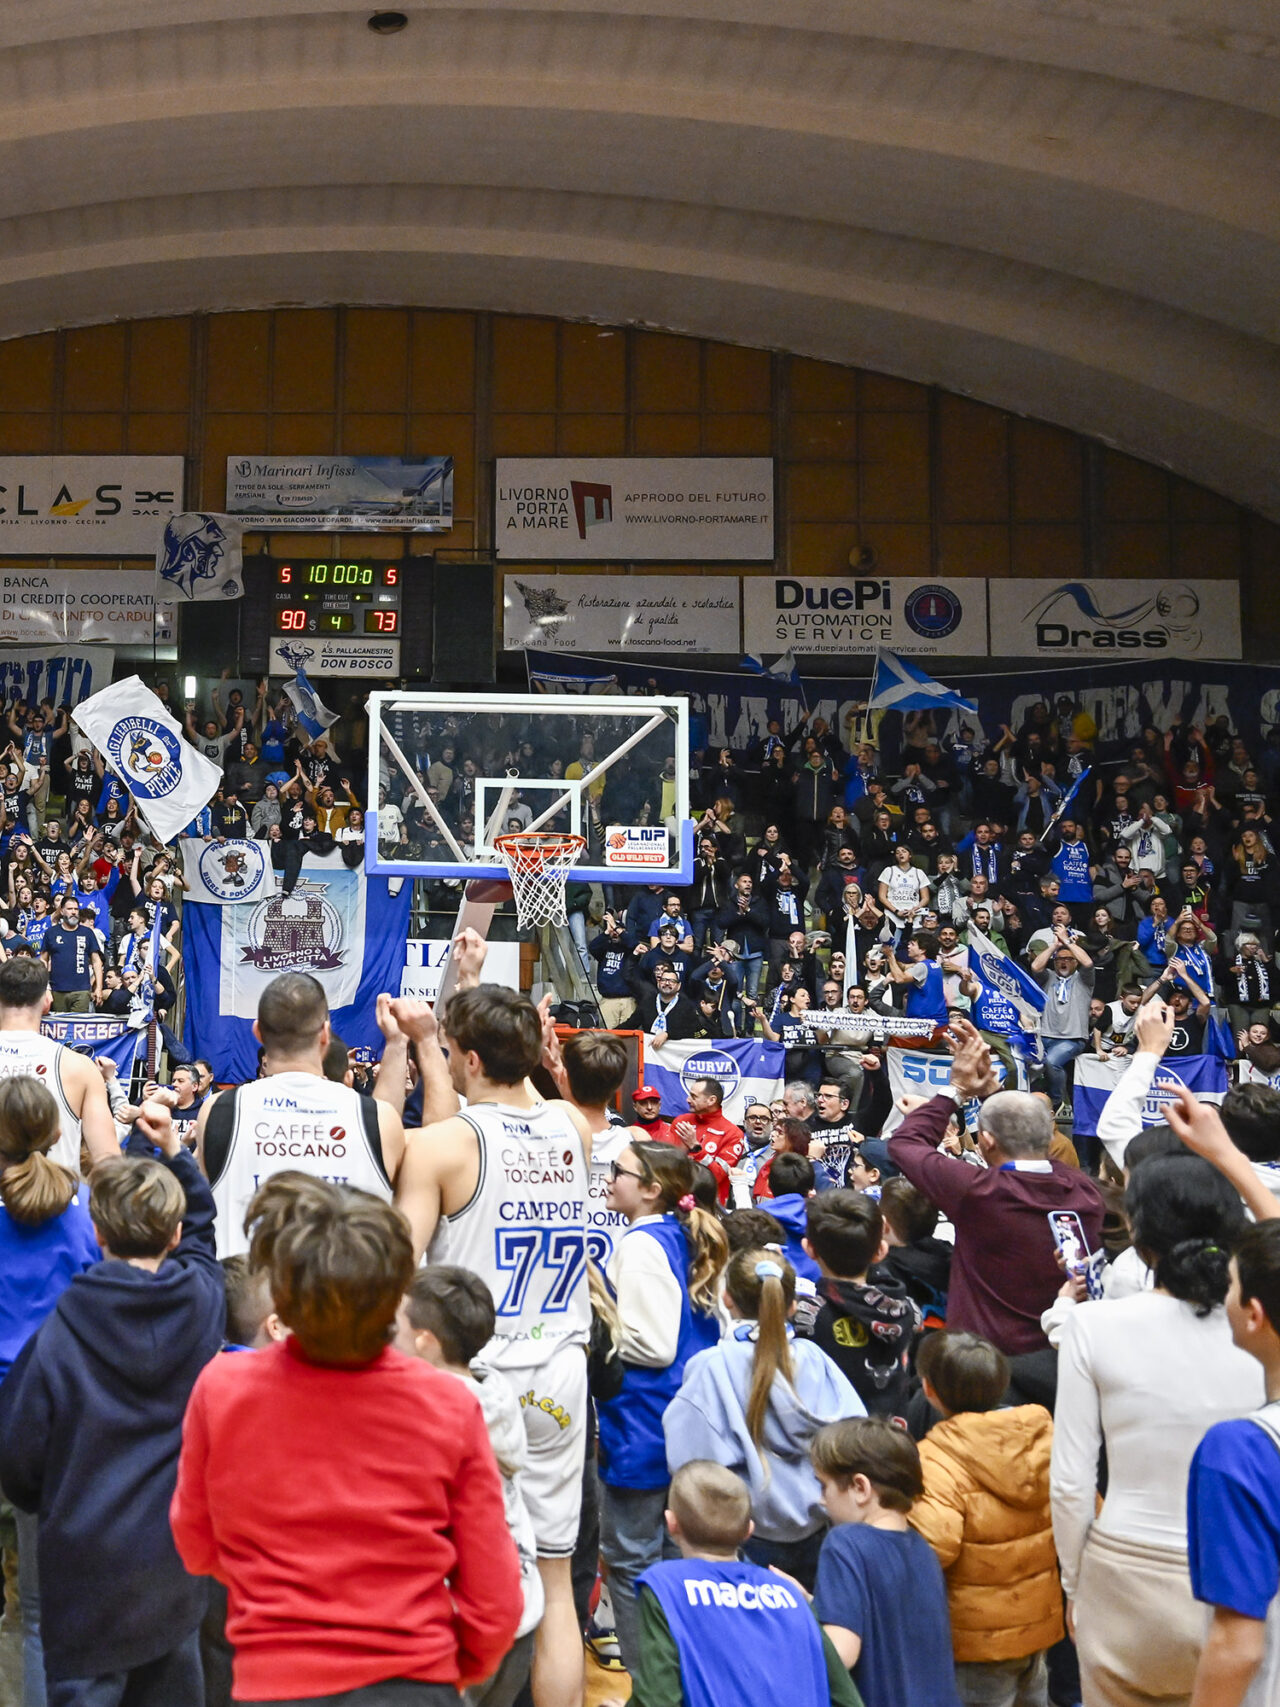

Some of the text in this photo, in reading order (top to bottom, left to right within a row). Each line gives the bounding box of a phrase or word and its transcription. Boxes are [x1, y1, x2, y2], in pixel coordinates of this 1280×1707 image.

[253, 463, 357, 480] Marinari Infissi
[499, 488, 569, 501] LIVORNO
[625, 493, 767, 503] APPRODO DEL FUTURO
[517, 502, 568, 515] PORTA
[507, 516, 569, 529] A MARE
[625, 515, 769, 524] WWW.LIVORNO-PORTAMARE.IT
[4, 577, 49, 587] BANCA
[3, 594, 75, 605] DI CREDITO
[578, 595, 631, 608] Ristorazione
[636, 597, 677, 608] aziendale
[691, 597, 734, 608] scolastica
[776, 580, 891, 610] DuePi
[2, 610, 15, 621] DI
[281, 610, 306, 630] 90
[373, 612, 397, 631] 73
[634, 615, 644, 625] di
[776, 614, 892, 626] AUTOMATION
[331, 616, 341, 630] 4
[776, 628, 892, 640] SERVICE
[1036, 624, 1168, 648] Drass
[553, 638, 576, 647] Food
[321, 659, 393, 669] DON BOSCO
[628, 829, 665, 841] LNP
[263, 948, 312, 963] LIVORNO
[256, 961, 270, 969] LA
[272, 960, 294, 968] MIA
[687, 1060, 732, 1073] CURVA
[263, 1097, 297, 1108] HVM
[502, 1122, 531, 1135] HVM
[256, 1142, 346, 1158] TOSCANO
[504, 1169, 574, 1184] TOSCANO
[495, 1227, 586, 1316] 77
